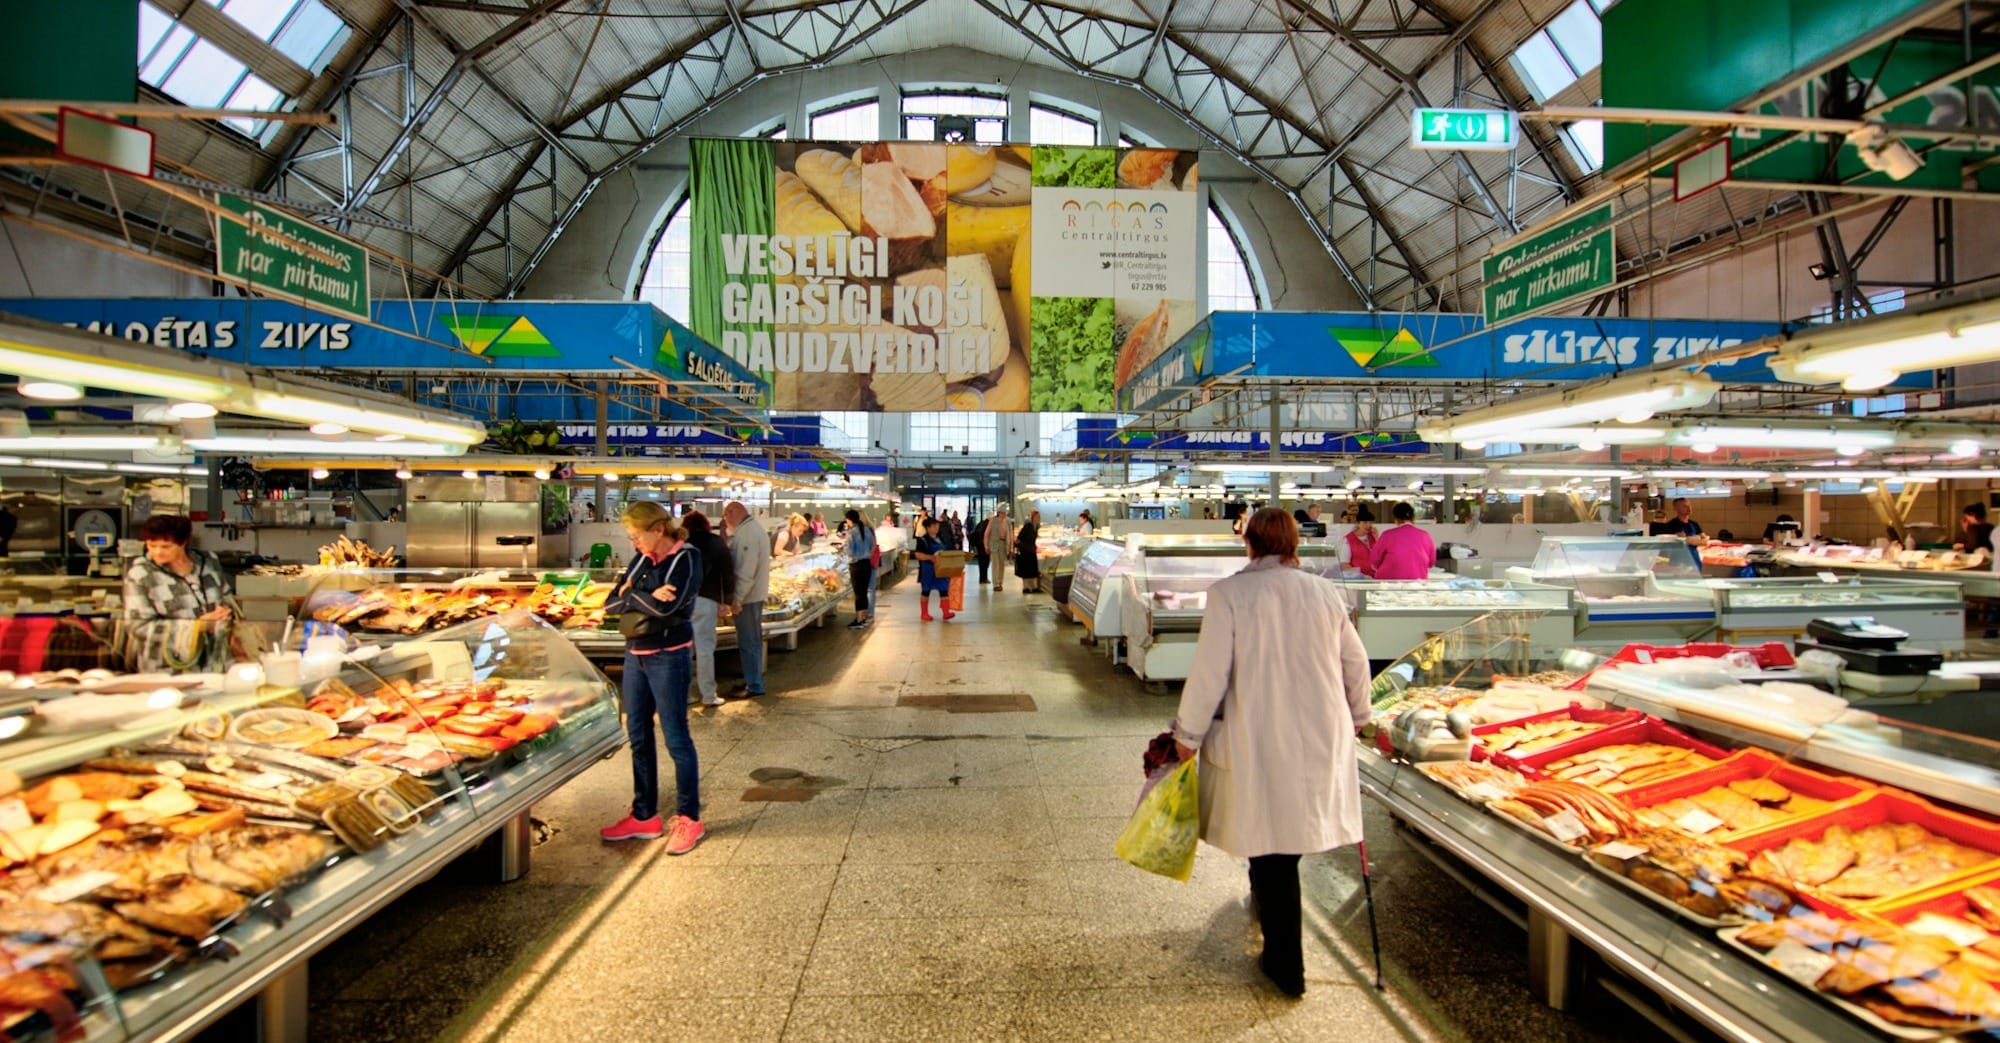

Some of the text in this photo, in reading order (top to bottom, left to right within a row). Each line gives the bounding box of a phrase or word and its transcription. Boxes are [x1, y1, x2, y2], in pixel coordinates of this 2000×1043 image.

[236, 247, 275, 275] par
[721, 231, 889, 278] VESELĪGI
[1099, 251, 1167, 260] www.centraltirgus.lv
[722, 276, 984, 327] GARŠĪGI KOŠI
[1131, 283, 1139, 291] 67
[1141, 283, 1153, 291] 229
[1495, 287, 1520, 318] par
[63, 316, 351, 351] DĒTAS ZIVIS
[722, 328, 992, 374] DAUDZVEIDĪGI
[1504, 329, 1743, 367] SĀLĪTAS ZIVIS
